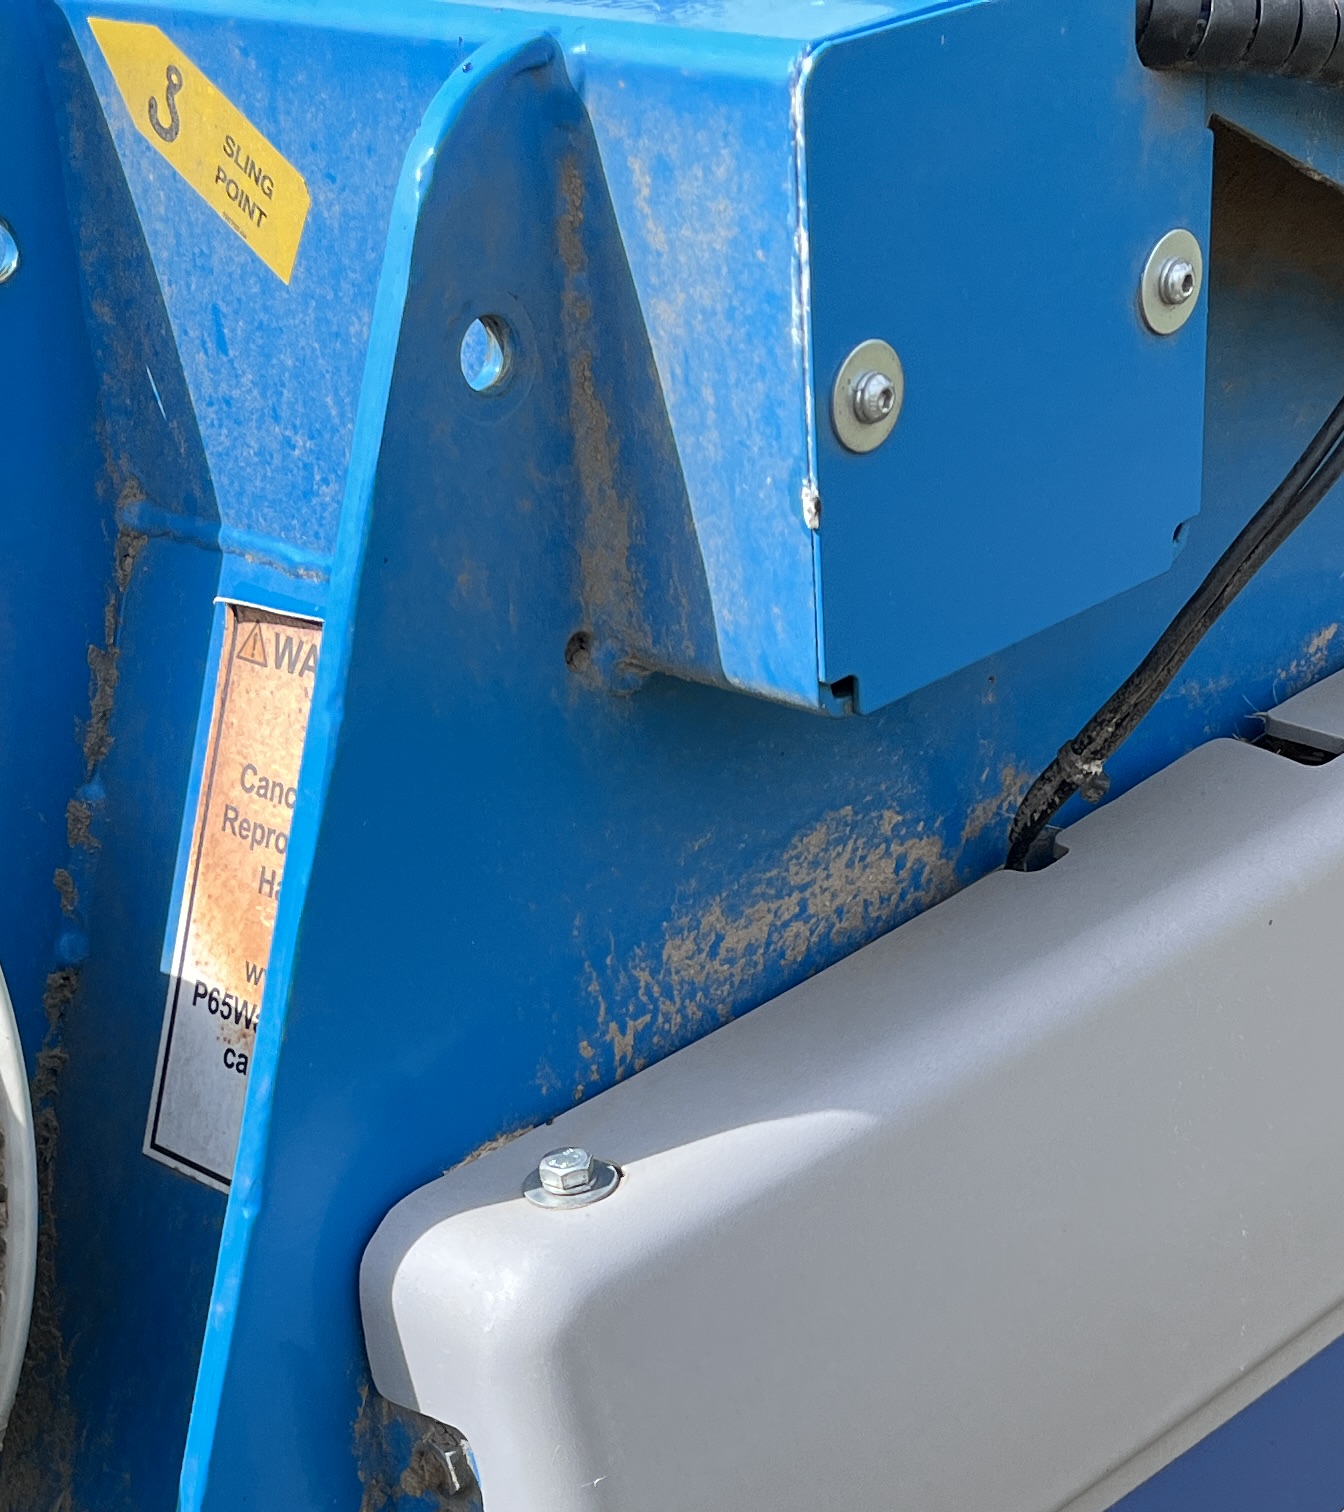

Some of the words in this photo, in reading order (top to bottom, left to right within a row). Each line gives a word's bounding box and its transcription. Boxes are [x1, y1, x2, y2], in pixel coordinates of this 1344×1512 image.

[222, 134, 275, 200] SLING
[214, 164, 268, 228] POINT
[240, 763, 296, 809] Canc
[221, 804, 288, 854] Repro
[246, 960, 267, 985] w
[223, 1048, 248, 1075] ca
